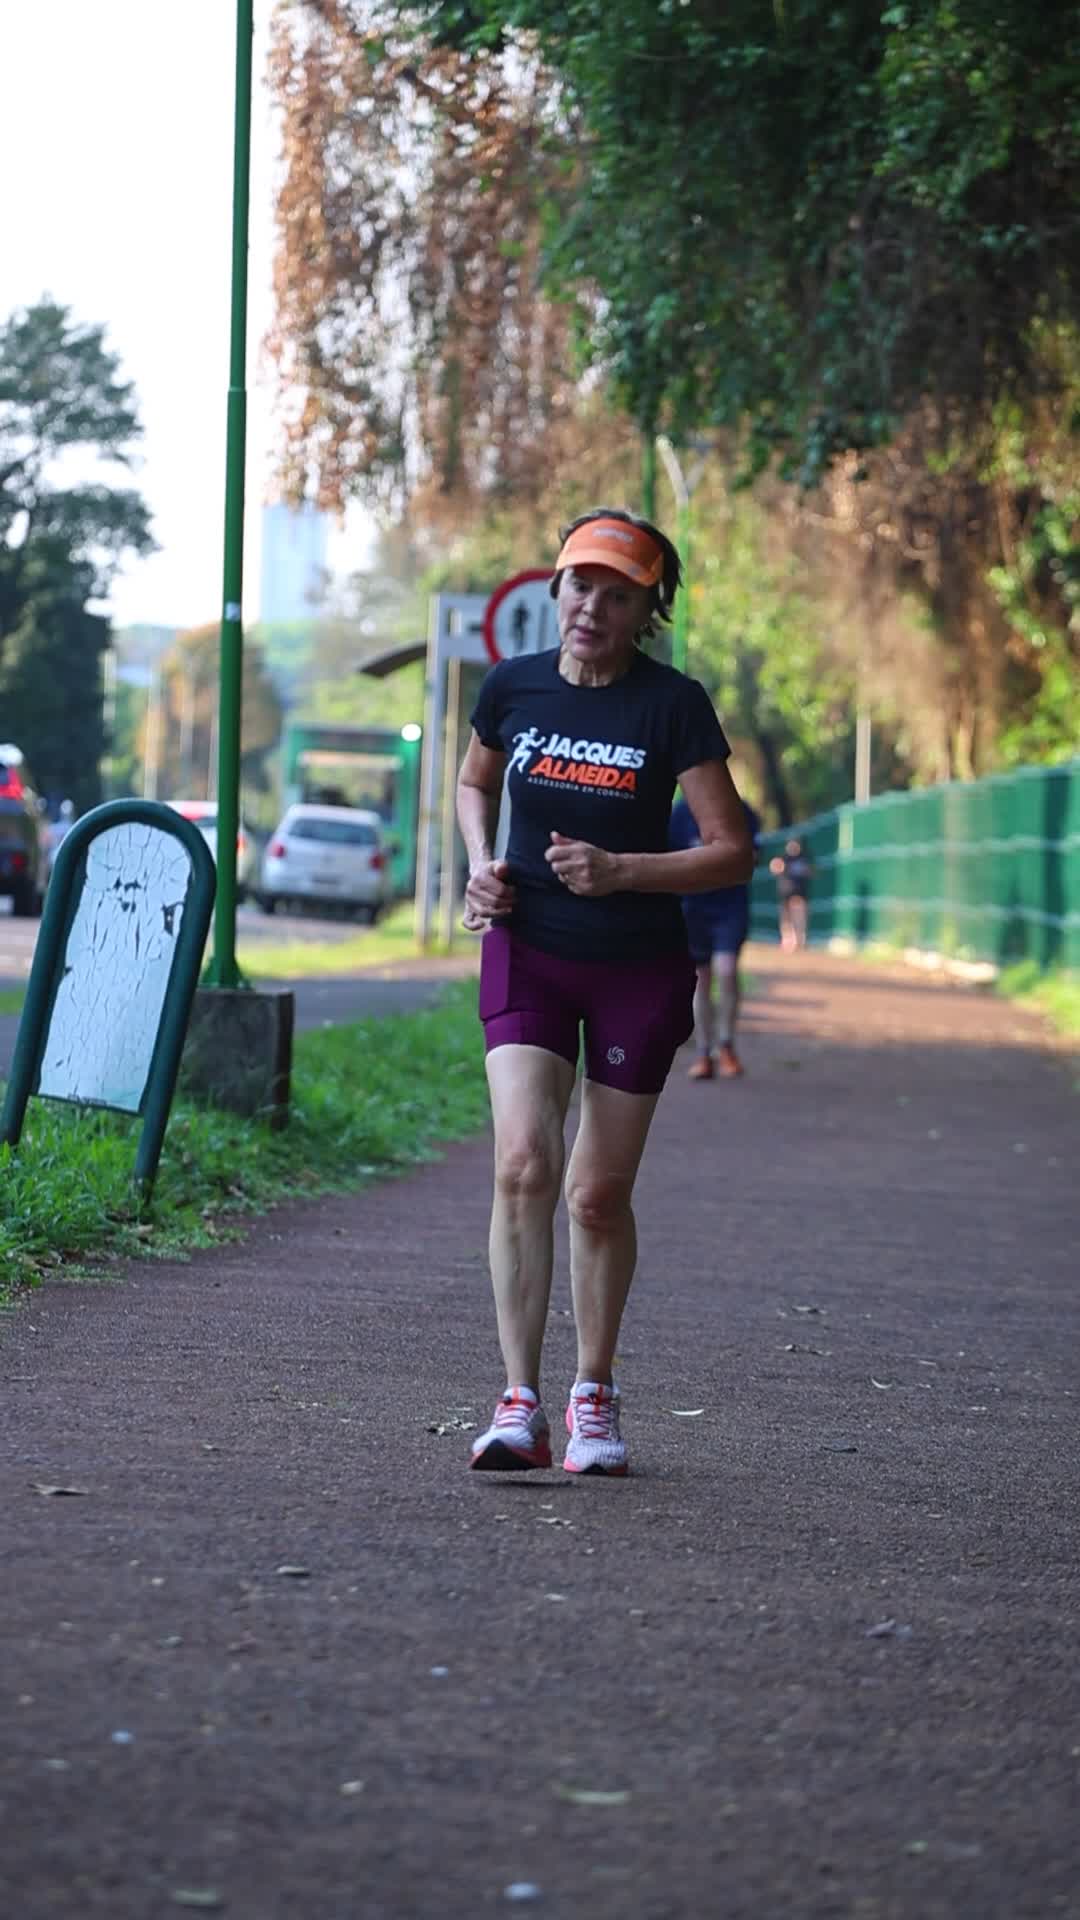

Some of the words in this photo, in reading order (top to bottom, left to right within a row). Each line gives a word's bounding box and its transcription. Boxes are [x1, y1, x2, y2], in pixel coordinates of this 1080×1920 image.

[541, 734, 646, 769] JACQUES
[527, 776, 579, 791] ASSESSORIA
[596, 788, 635, 799] CORRIDA
[530, 756, 637, 791] ALMEIDA
